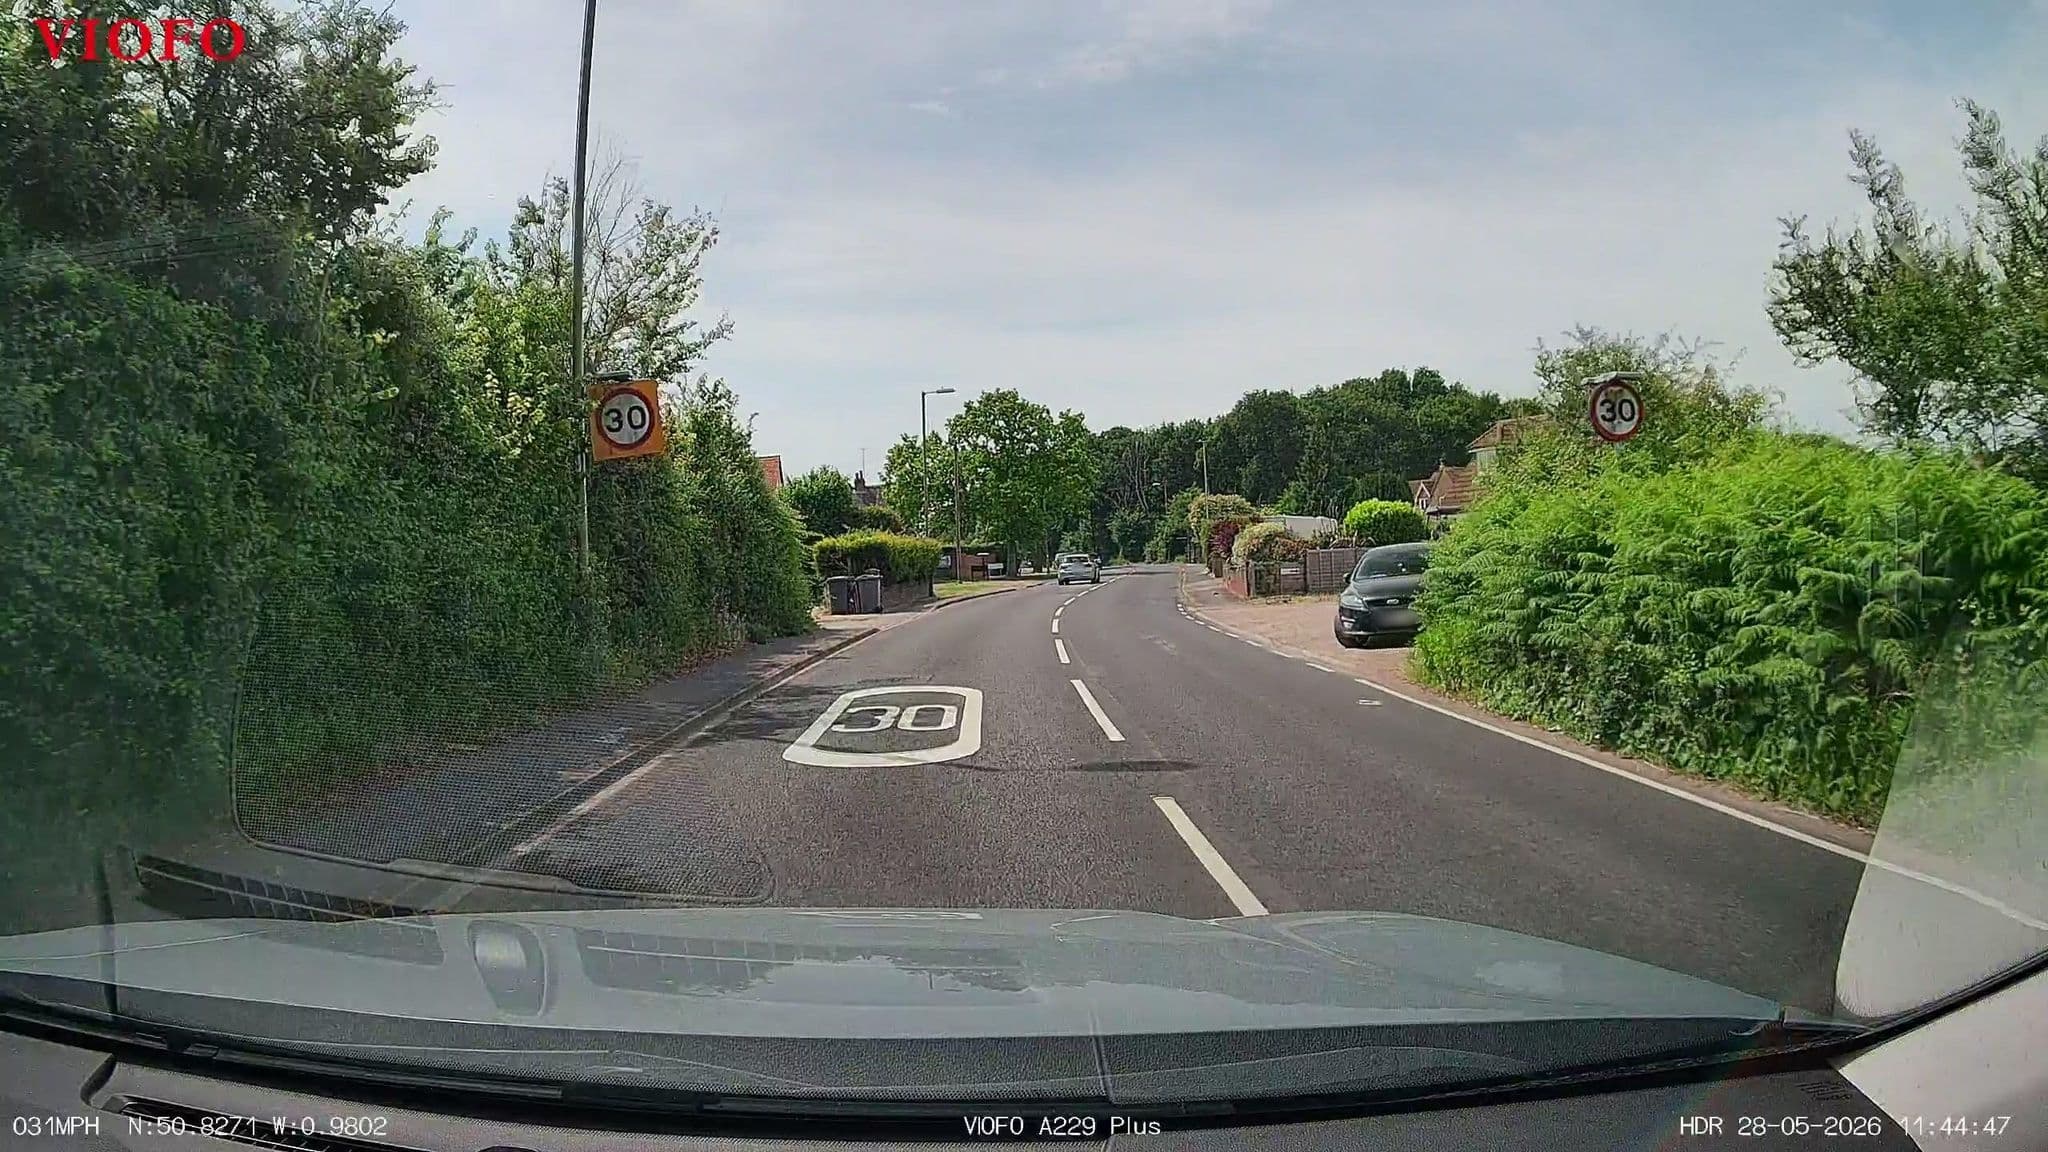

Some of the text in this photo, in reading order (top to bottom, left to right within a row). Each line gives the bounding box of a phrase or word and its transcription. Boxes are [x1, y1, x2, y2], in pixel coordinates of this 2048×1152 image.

[605, 405, 646, 432] 30
[1600, 399, 1636, 422] 30
[832, 705, 958, 732] 30
